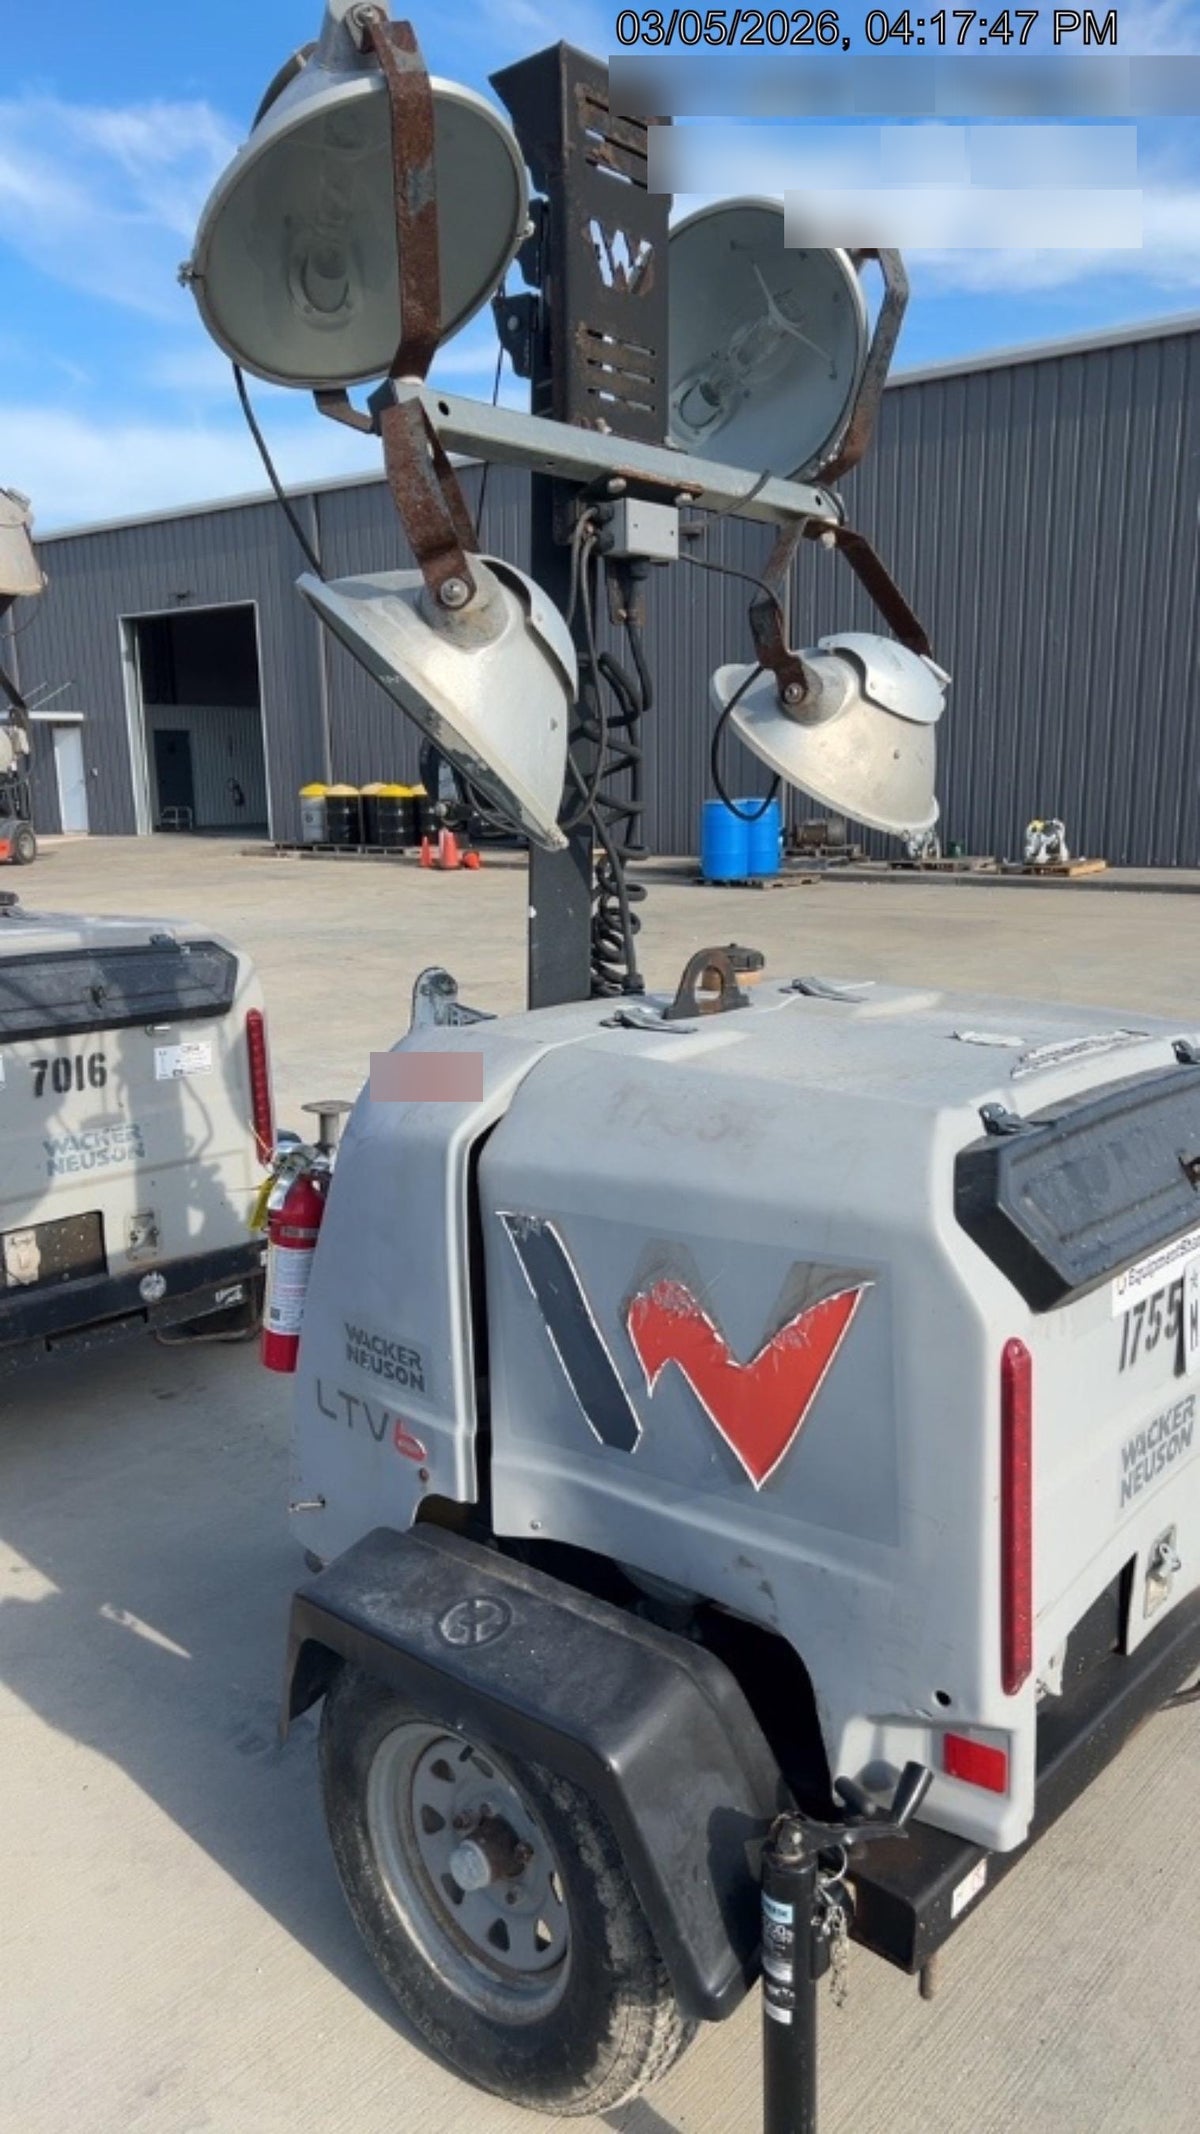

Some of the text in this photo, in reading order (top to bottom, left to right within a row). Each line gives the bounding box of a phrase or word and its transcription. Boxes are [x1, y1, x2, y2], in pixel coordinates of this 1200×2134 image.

[30, 1052, 108, 1097] 7016
[42, 1123, 143, 1158] WACKER
[46, 1141, 146, 1177] NEUSON
[344, 1322, 422, 1372] WACKER
[346, 1342, 426, 1393] NEUSON
[1121, 1394, 1196, 1473] WACKER
[1120, 1418, 1195, 1509] NEUSON
